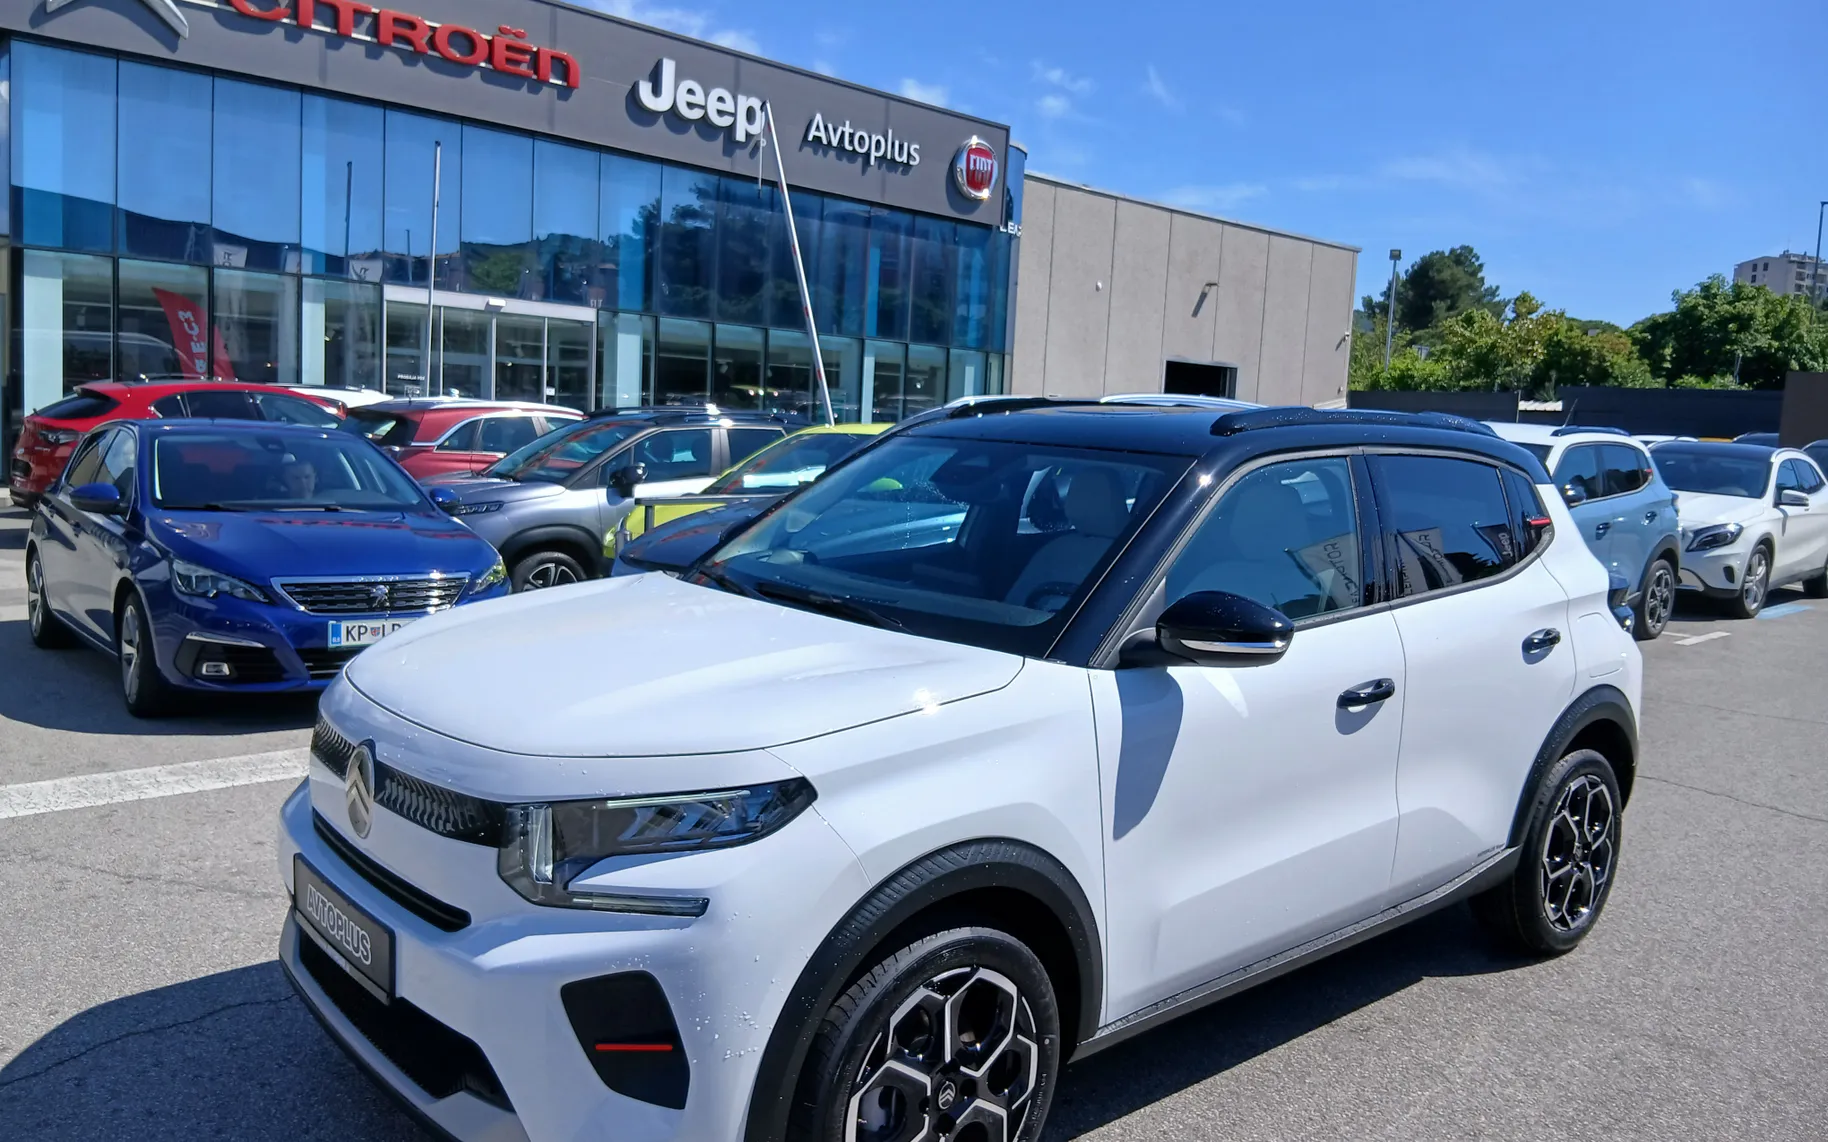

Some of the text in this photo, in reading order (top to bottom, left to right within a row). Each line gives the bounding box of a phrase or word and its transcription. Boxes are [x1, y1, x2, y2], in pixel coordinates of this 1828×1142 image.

[638, 57, 765, 142] Jeep
[807, 113, 920, 166] Avtoplus
[969, 154, 992, 172] FIAT
[1498, 532, 1513, 557] Jeep
[346, 624, 368, 642] KP
[307, 884, 372, 965] AVTOPLUS
